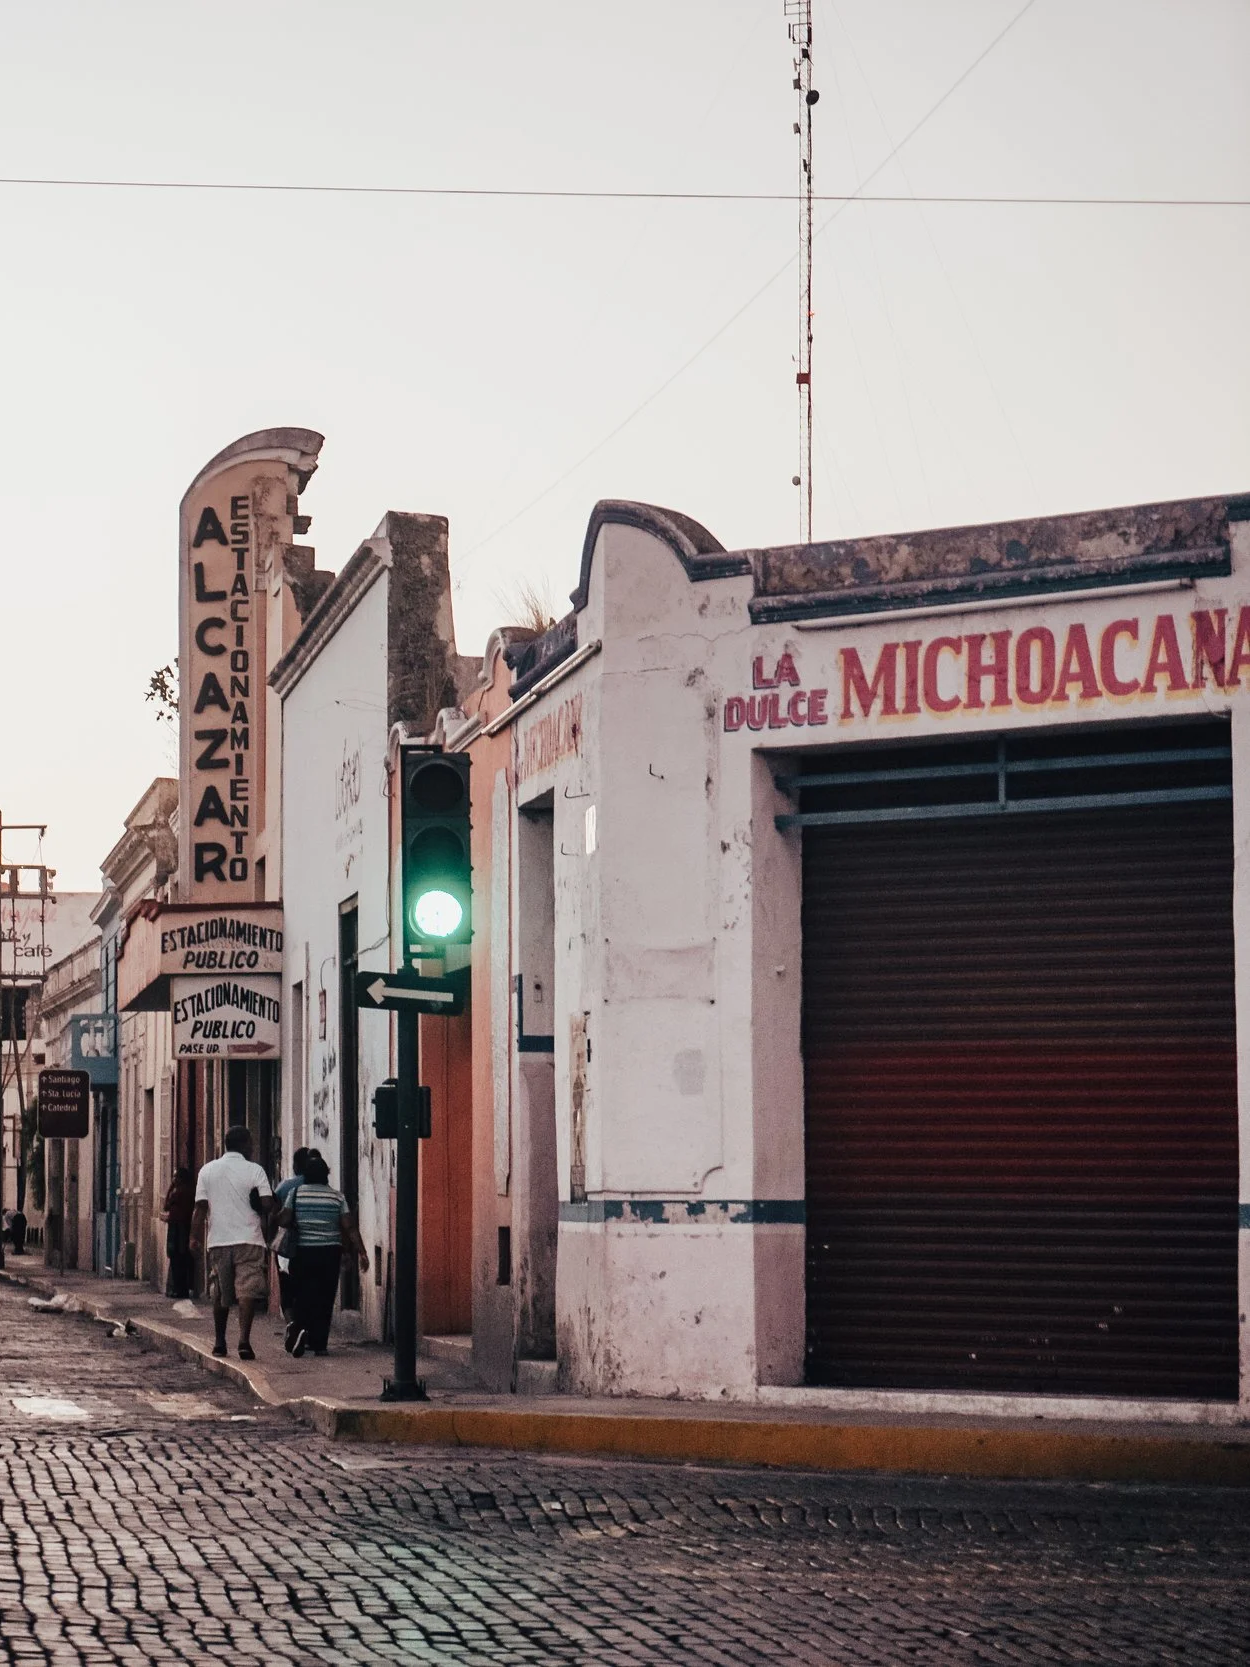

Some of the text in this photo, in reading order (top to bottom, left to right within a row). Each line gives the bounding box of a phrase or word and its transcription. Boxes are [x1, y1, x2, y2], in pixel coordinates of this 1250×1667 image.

[753, 650, 801, 690] LA
[192, 506, 230, 883] ALCAZAR
[230, 495, 250, 882] ESTACIONAMIENTO
[724, 688, 829, 733] DULCE
[161, 917, 283, 953] ESTACIONAMIENTO
[182, 950, 259, 969] PUBLICO
[174, 981, 280, 1024] ESTACIONAMIENTO
[191, 1020, 256, 1039] PUBLICO
[178, 1043, 204, 1054] PASE
[48, 1074, 81, 1085] Santiago
[47, 1103, 78, 1112] Catedral
